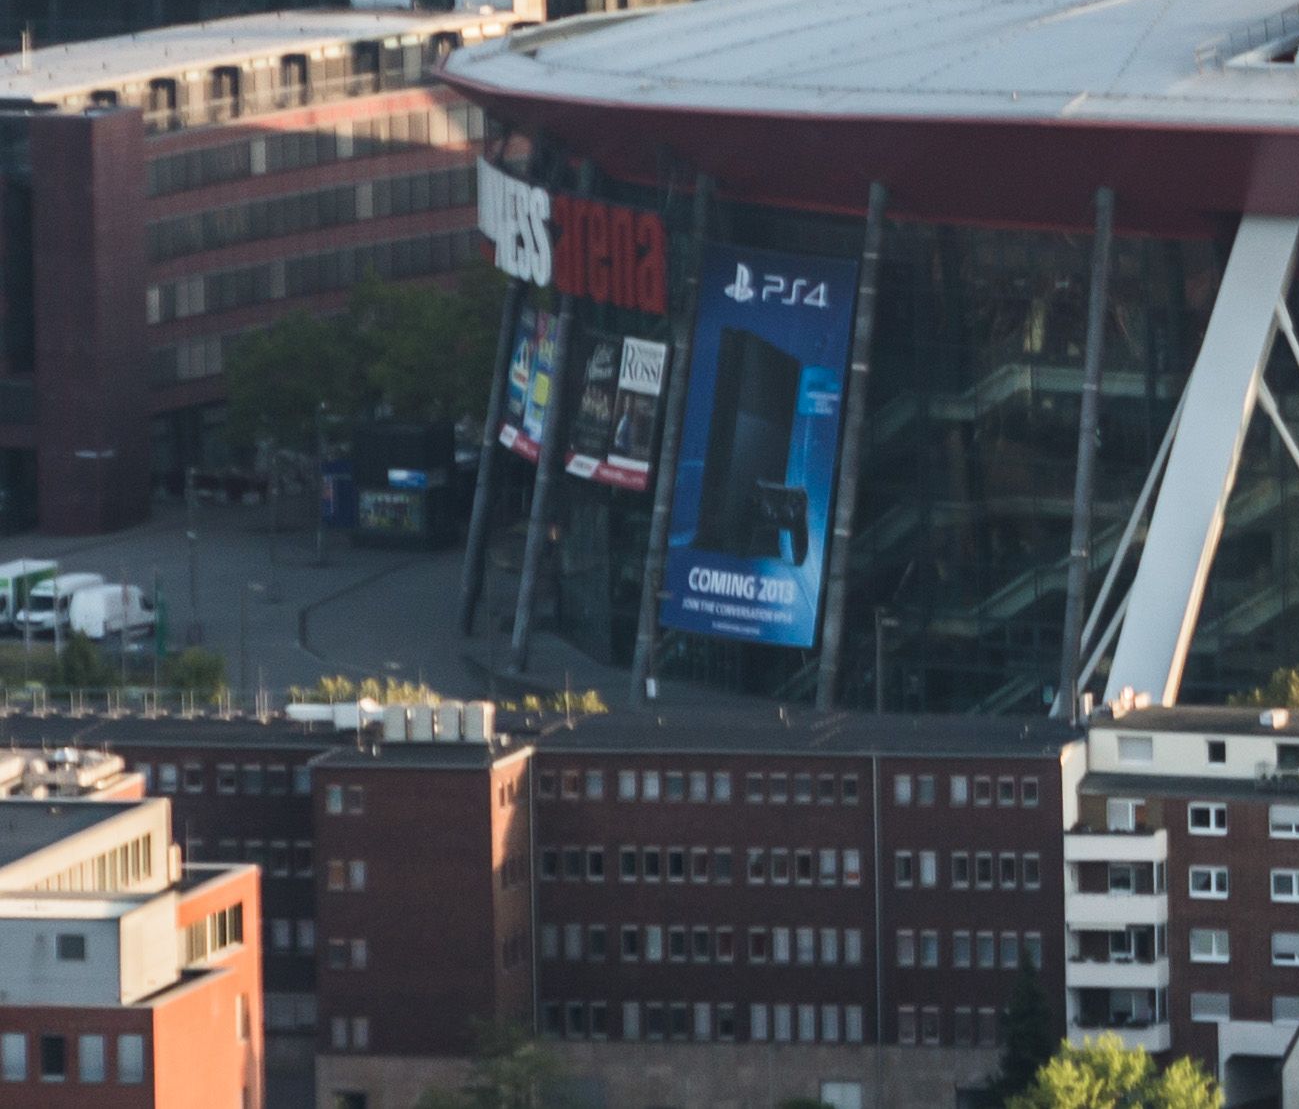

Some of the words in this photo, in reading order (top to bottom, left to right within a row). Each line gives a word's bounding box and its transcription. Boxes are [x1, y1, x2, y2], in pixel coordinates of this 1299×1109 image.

[553, 191, 668, 315] arena
[761, 274, 828, 308] PS4
[688, 566, 755, 600] COMING
[757, 577, 795, 605] 2013
